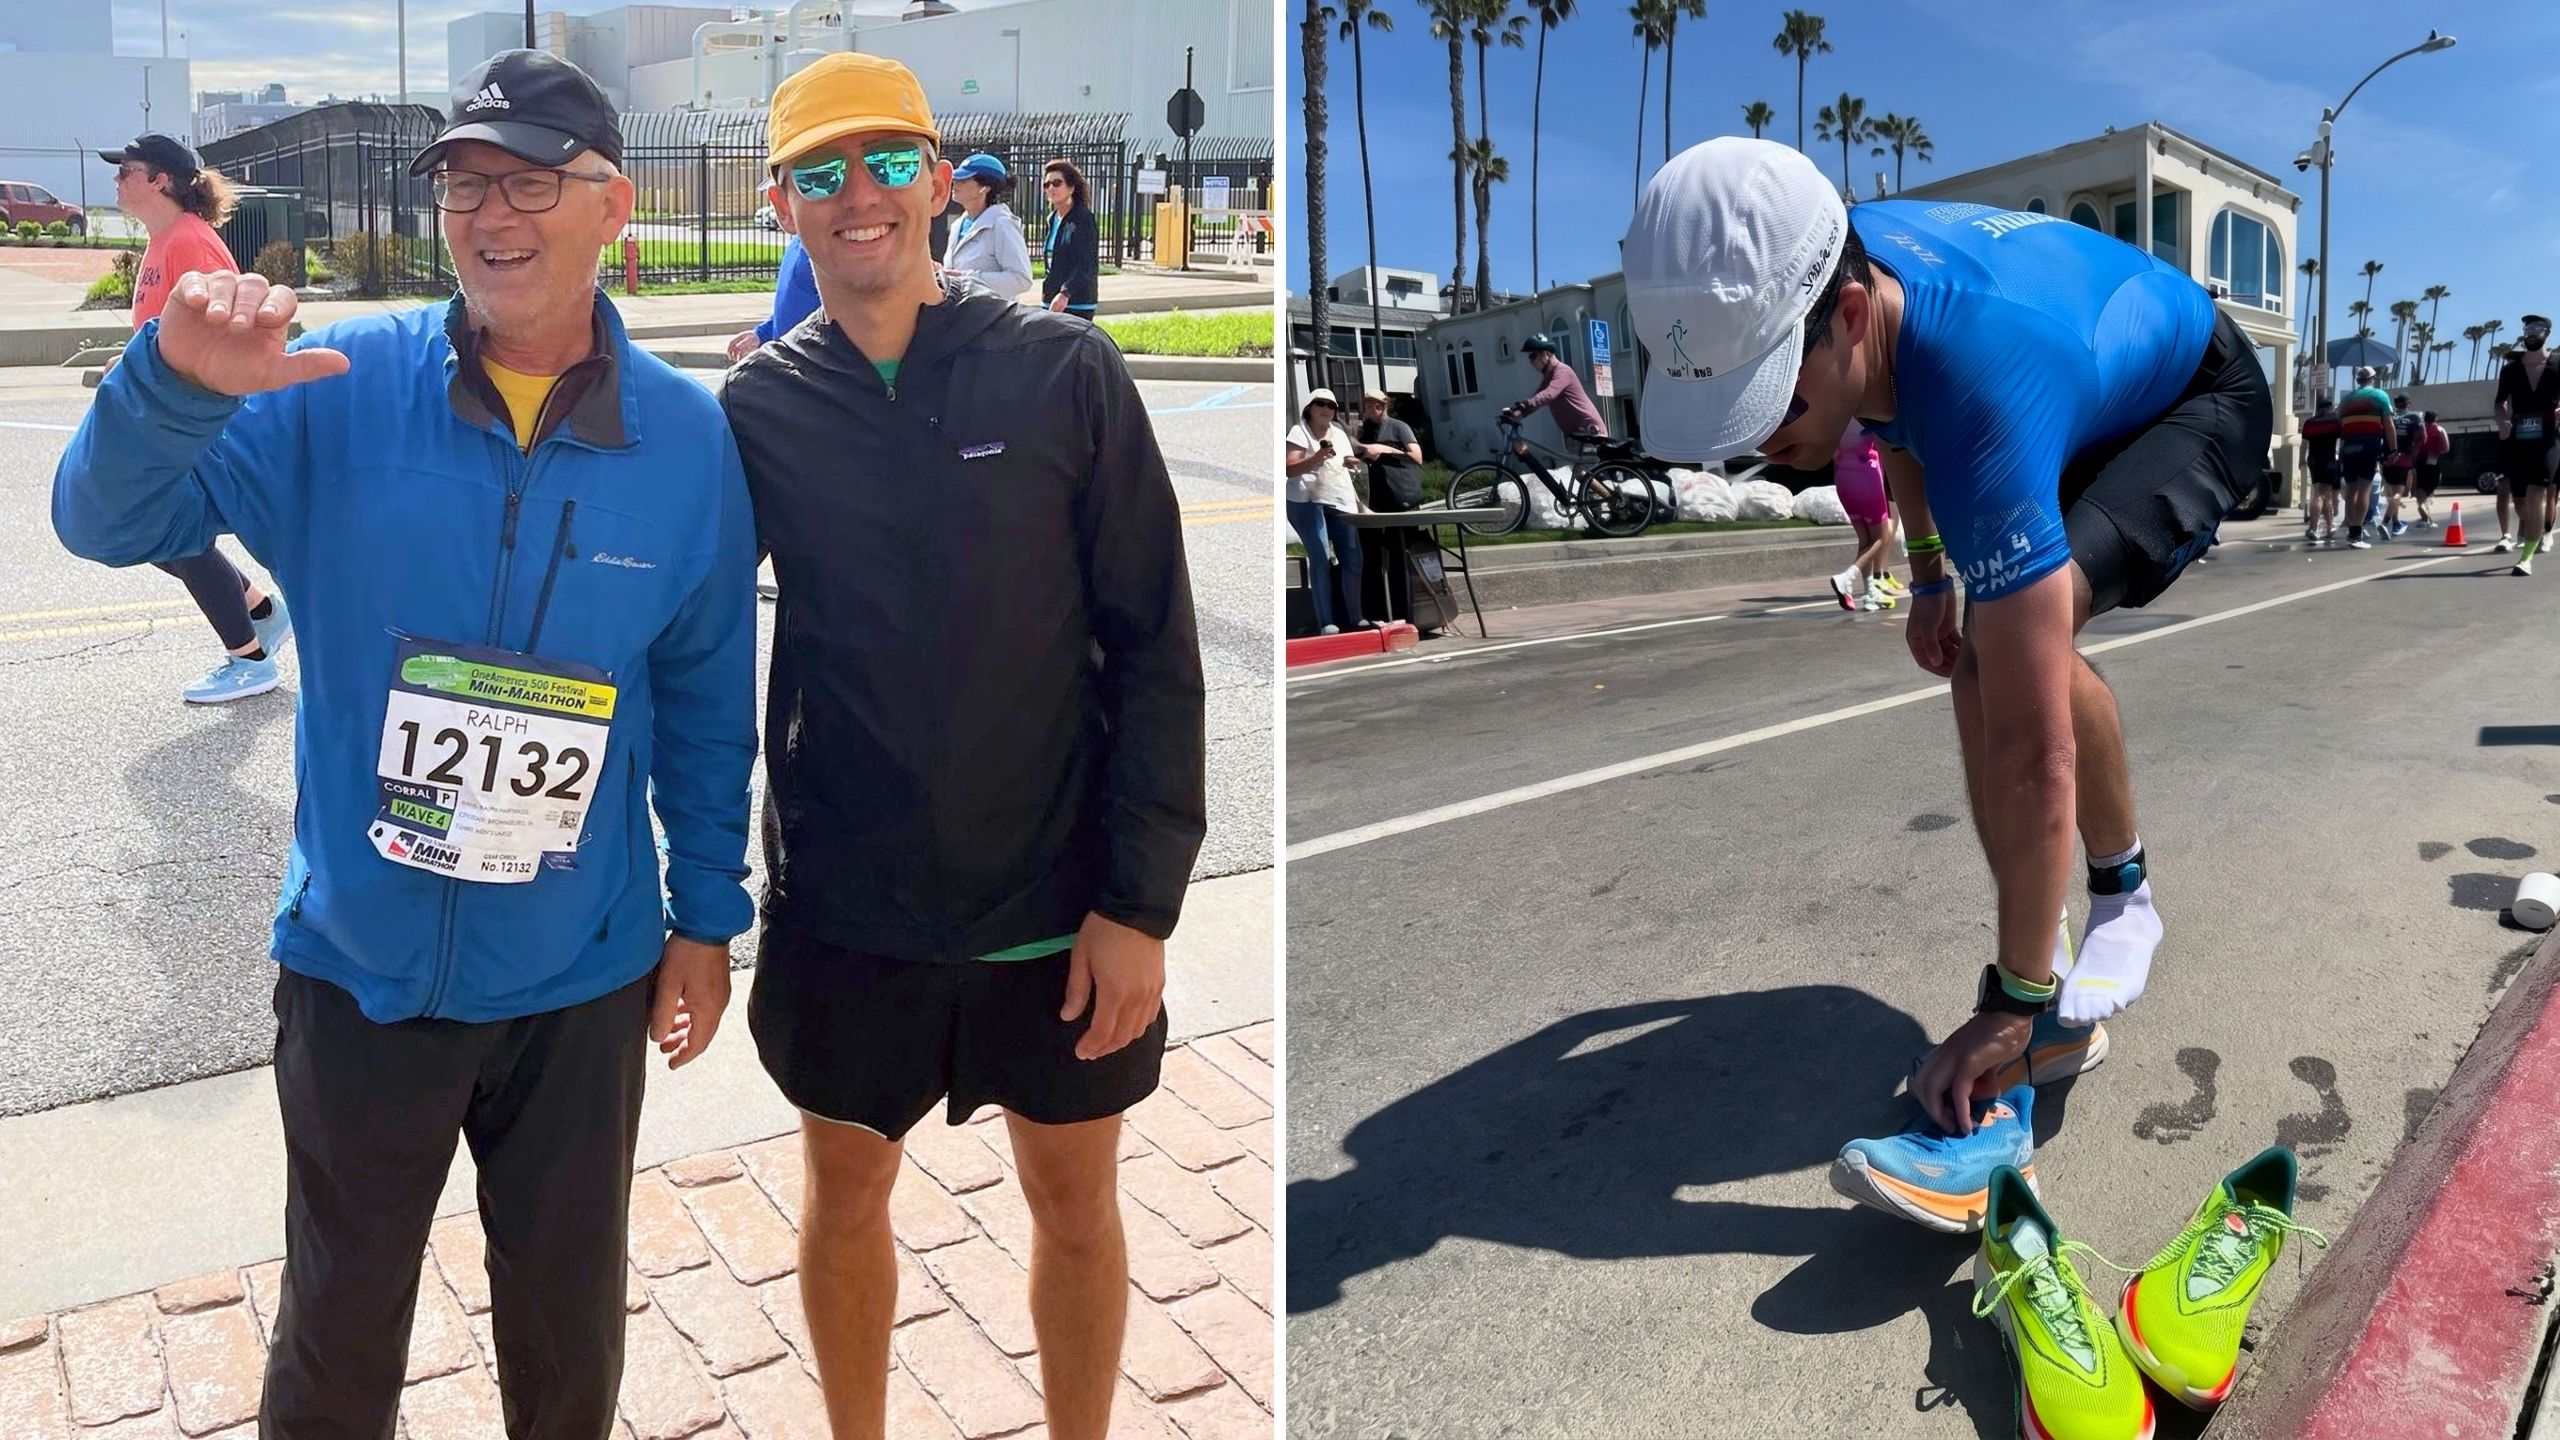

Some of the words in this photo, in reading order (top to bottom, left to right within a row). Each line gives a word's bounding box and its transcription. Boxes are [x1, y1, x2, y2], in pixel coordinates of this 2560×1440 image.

[466, 98, 510, 112] adidas
[963, 448, 1002, 460] patagonia
[2012, 532, 2031, 553] 4
[471, 669, 528, 687] OneAmerica
[531, 678, 549, 690] 500
[551, 682, 587, 697] Festival
[469, 680, 586, 710] MINI-MARATHON
[467, 710, 528, 734] RALPH
[399, 720, 589, 801] 12132
[384, 782, 431, 799] CORRAL
[442, 793, 451, 804] P
[396, 802, 434, 824] WAVE
[436, 815, 445, 827] 4
[411, 855, 457, 872] MARATHON
[414, 842, 461, 864] MINI
[501, 862, 532, 873] 12132
